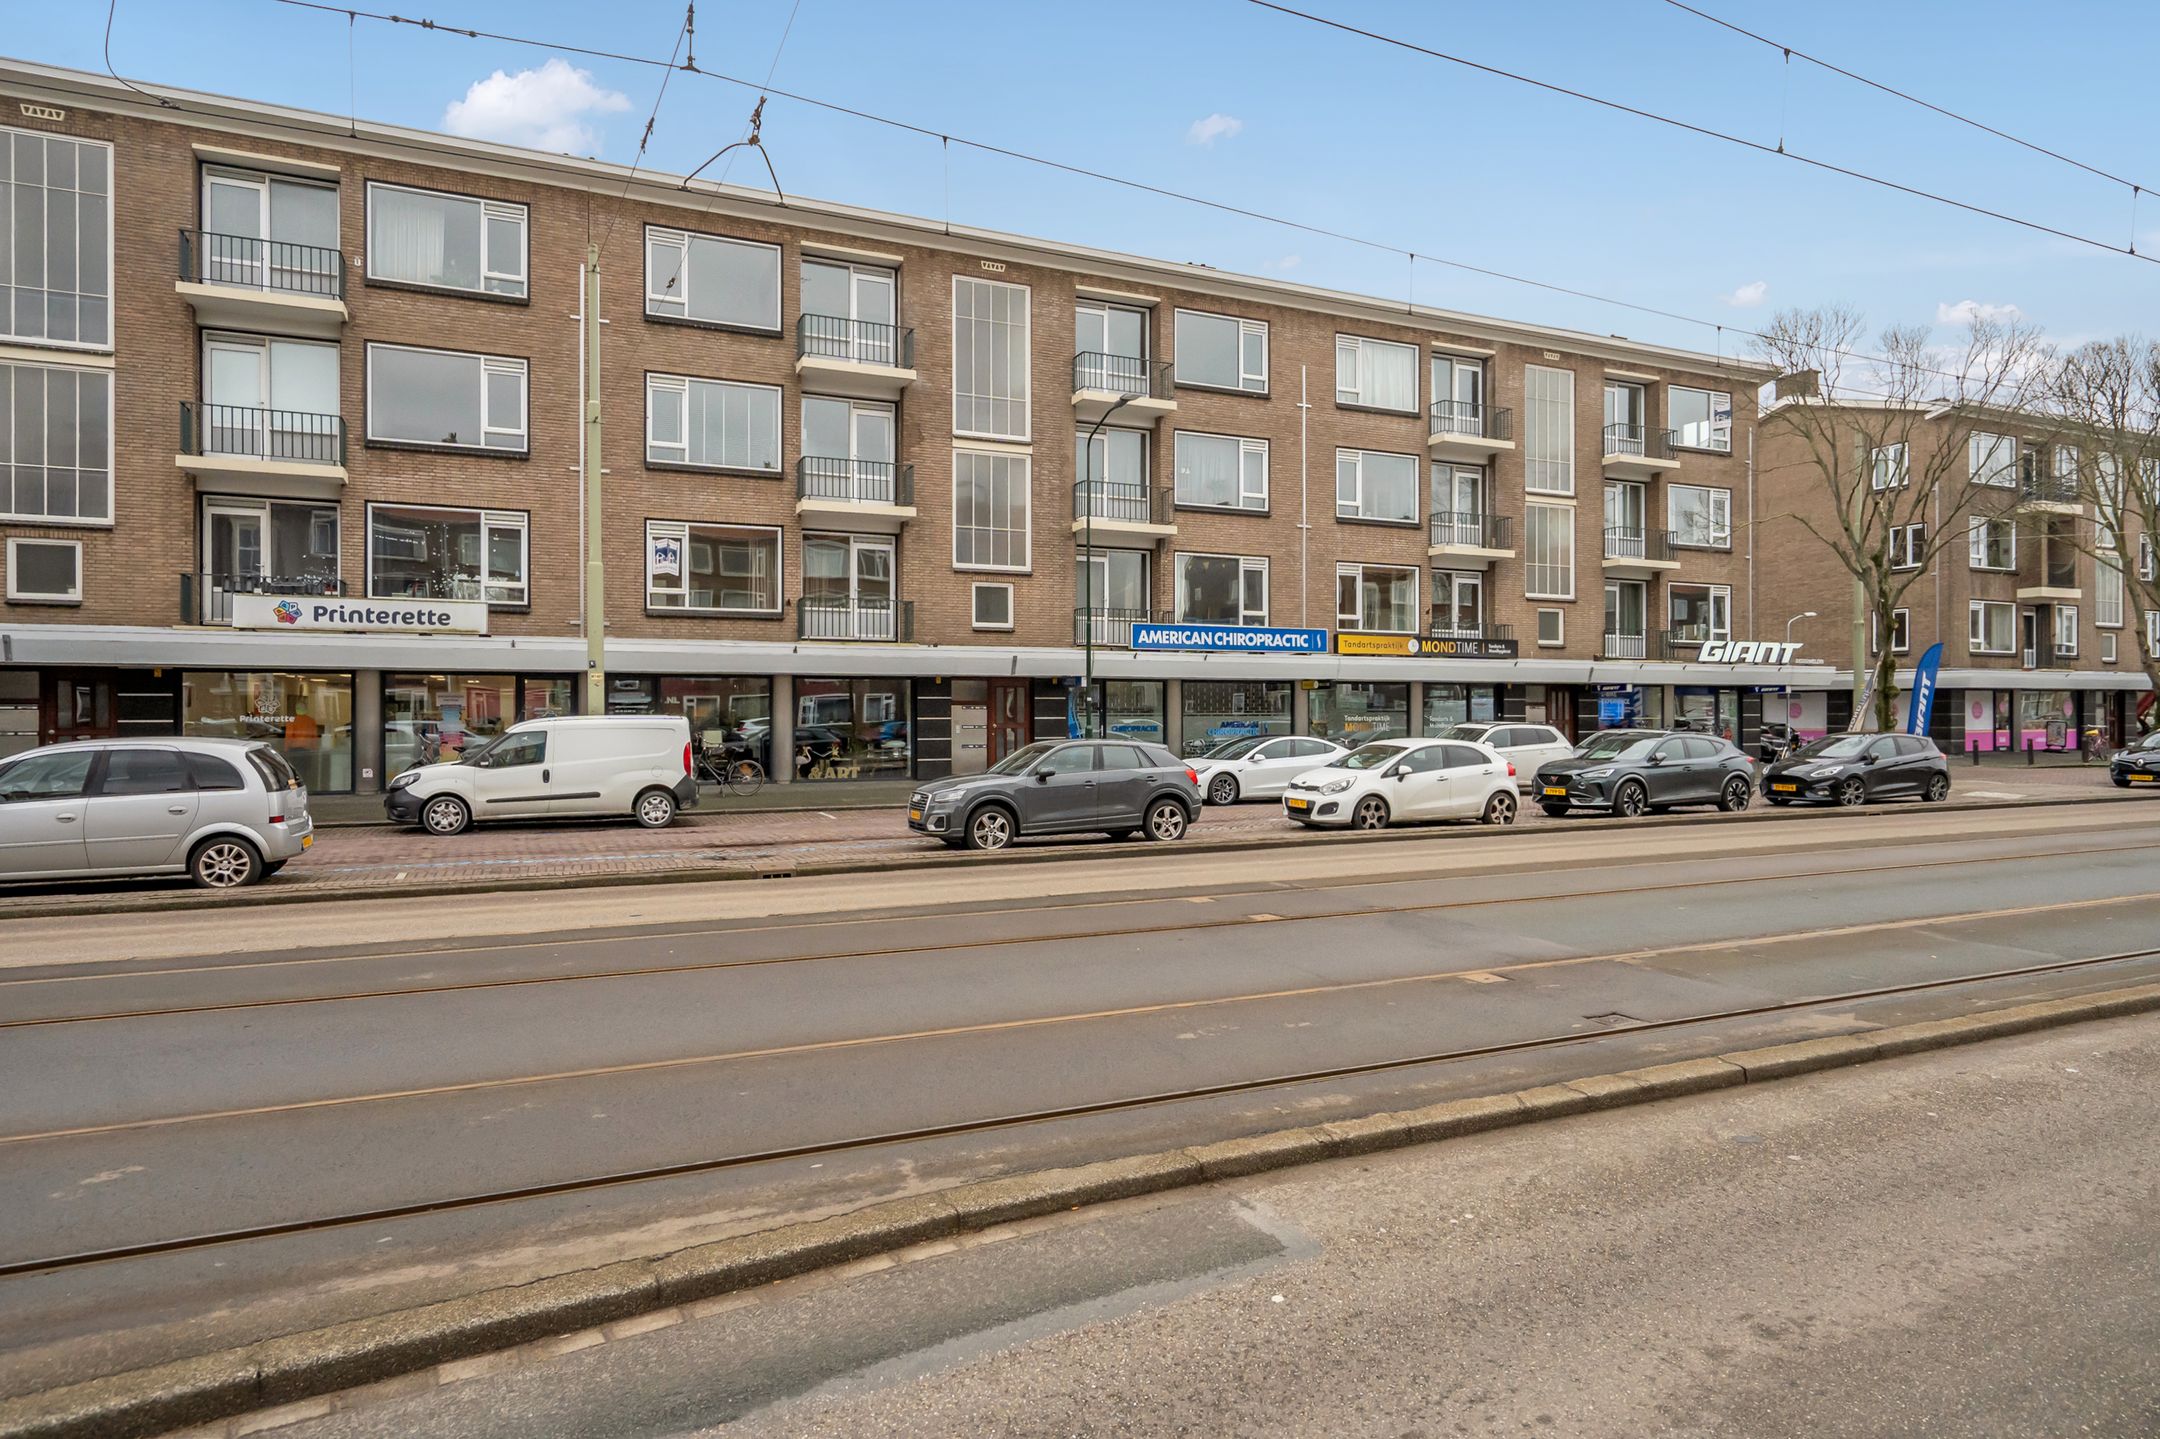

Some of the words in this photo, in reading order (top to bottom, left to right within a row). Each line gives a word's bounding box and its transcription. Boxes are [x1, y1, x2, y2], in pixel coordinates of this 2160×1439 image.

[313, 604, 452, 627] Printerette
[1138, 629, 1213, 645] AMERICAN
[1214, 632, 1309, 648] CHIROPRACTIC
[1343, 640, 1403, 650] Tandartspraktijk
[1422, 640, 1479, 654] MONDTIME
[1698, 640, 1804, 664] GIANT
[239, 714, 296, 723] Printerette
[824, 766, 861, 779] ART
